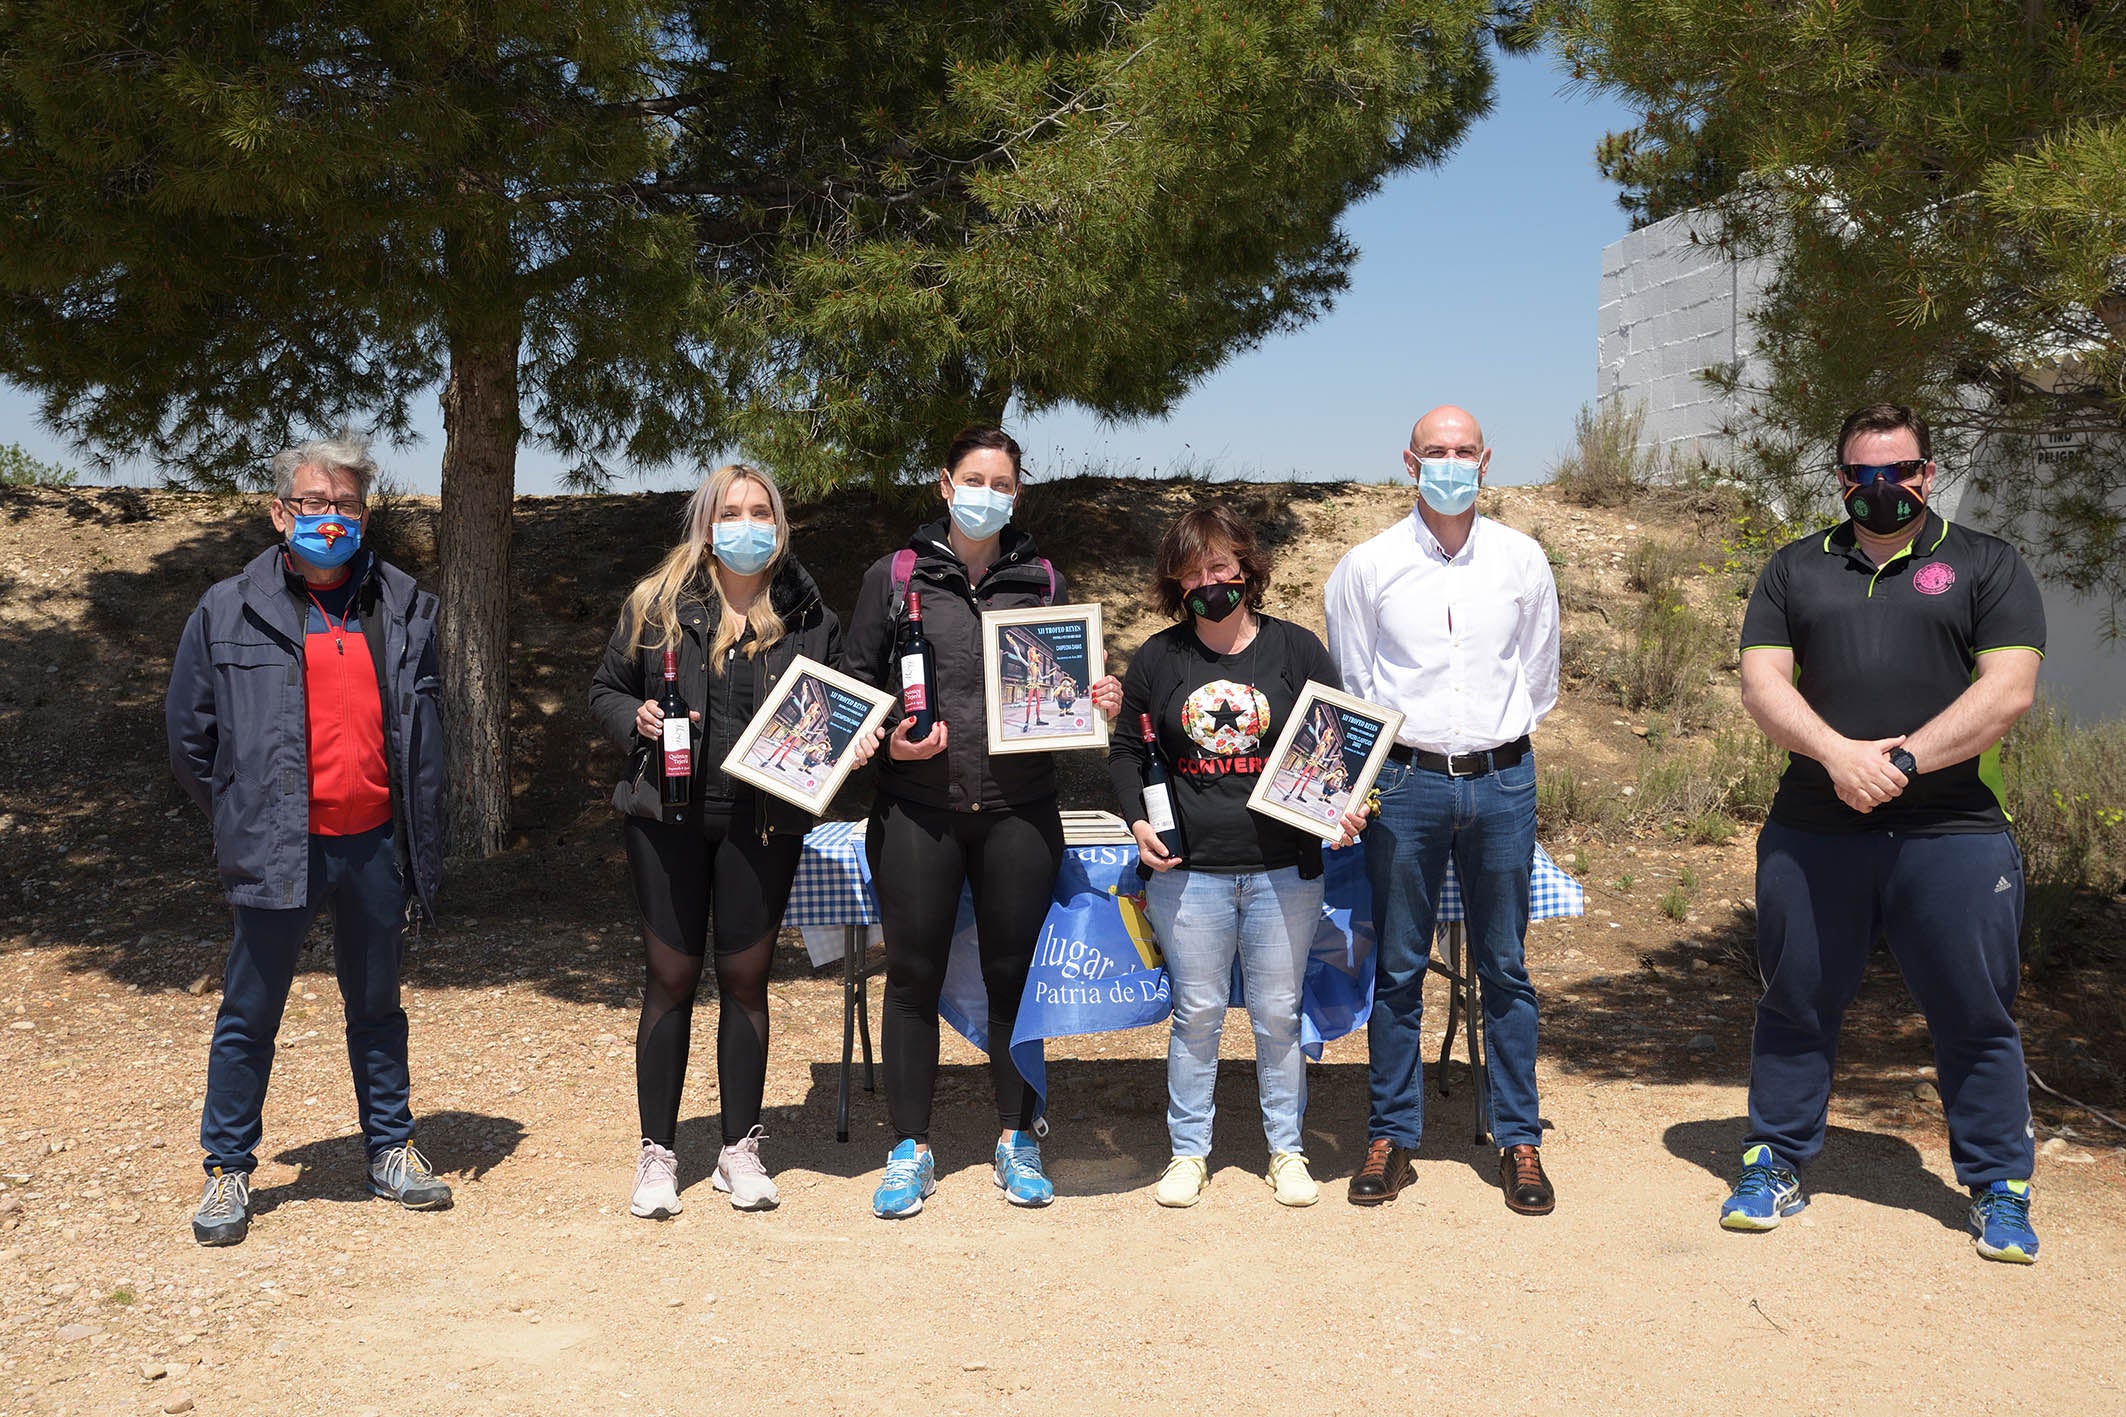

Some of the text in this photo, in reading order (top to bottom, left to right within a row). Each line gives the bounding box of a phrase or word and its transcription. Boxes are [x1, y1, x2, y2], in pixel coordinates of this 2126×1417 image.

[1045, 625, 1065, 634] TROFEO
[1065, 624, 1081, 633] REYES
[1041, 922, 1115, 980] lugar
[1035, 980, 1101, 1004] Patria
[1109, 980, 1135, 1004] de
